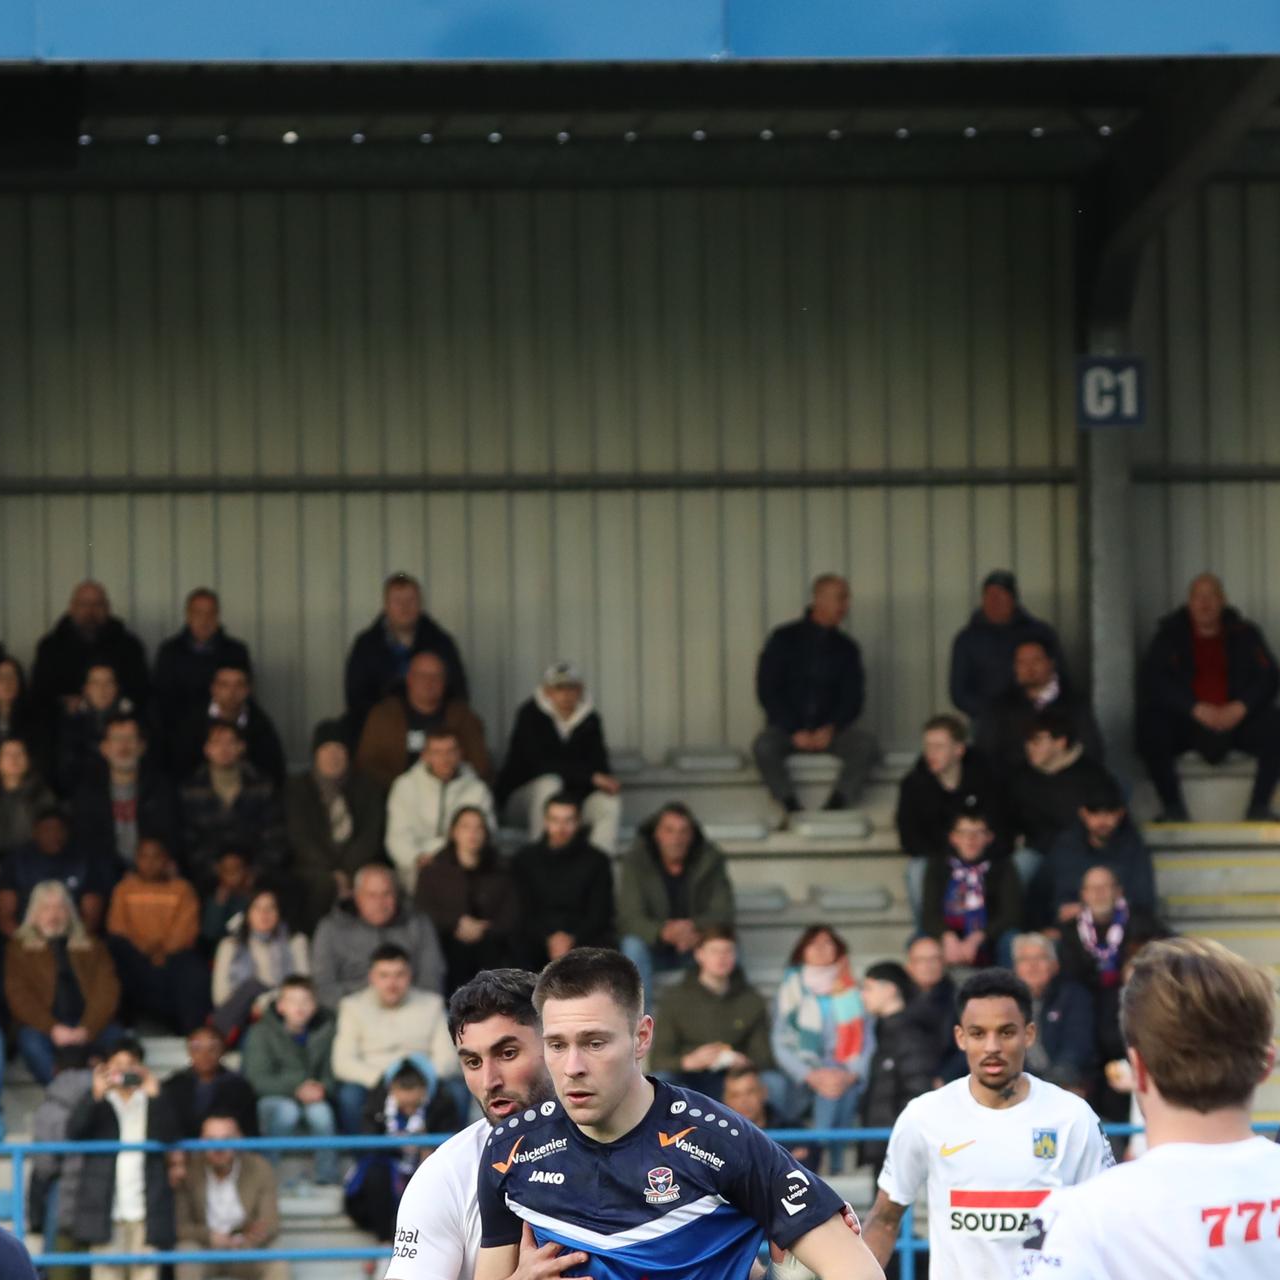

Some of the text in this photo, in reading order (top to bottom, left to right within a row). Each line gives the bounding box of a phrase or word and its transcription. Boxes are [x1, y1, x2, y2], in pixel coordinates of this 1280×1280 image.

[1083, 366, 1138, 418] C1
[511, 1138, 567, 1164] Valckenier
[676, 1137, 725, 1168] Valckenier
[528, 1170, 565, 1185] JAKO
[787, 1187, 808, 1201] League
[789, 1184, 800, 1193] Pro
[951, 1212, 1031, 1231] SOUDA
